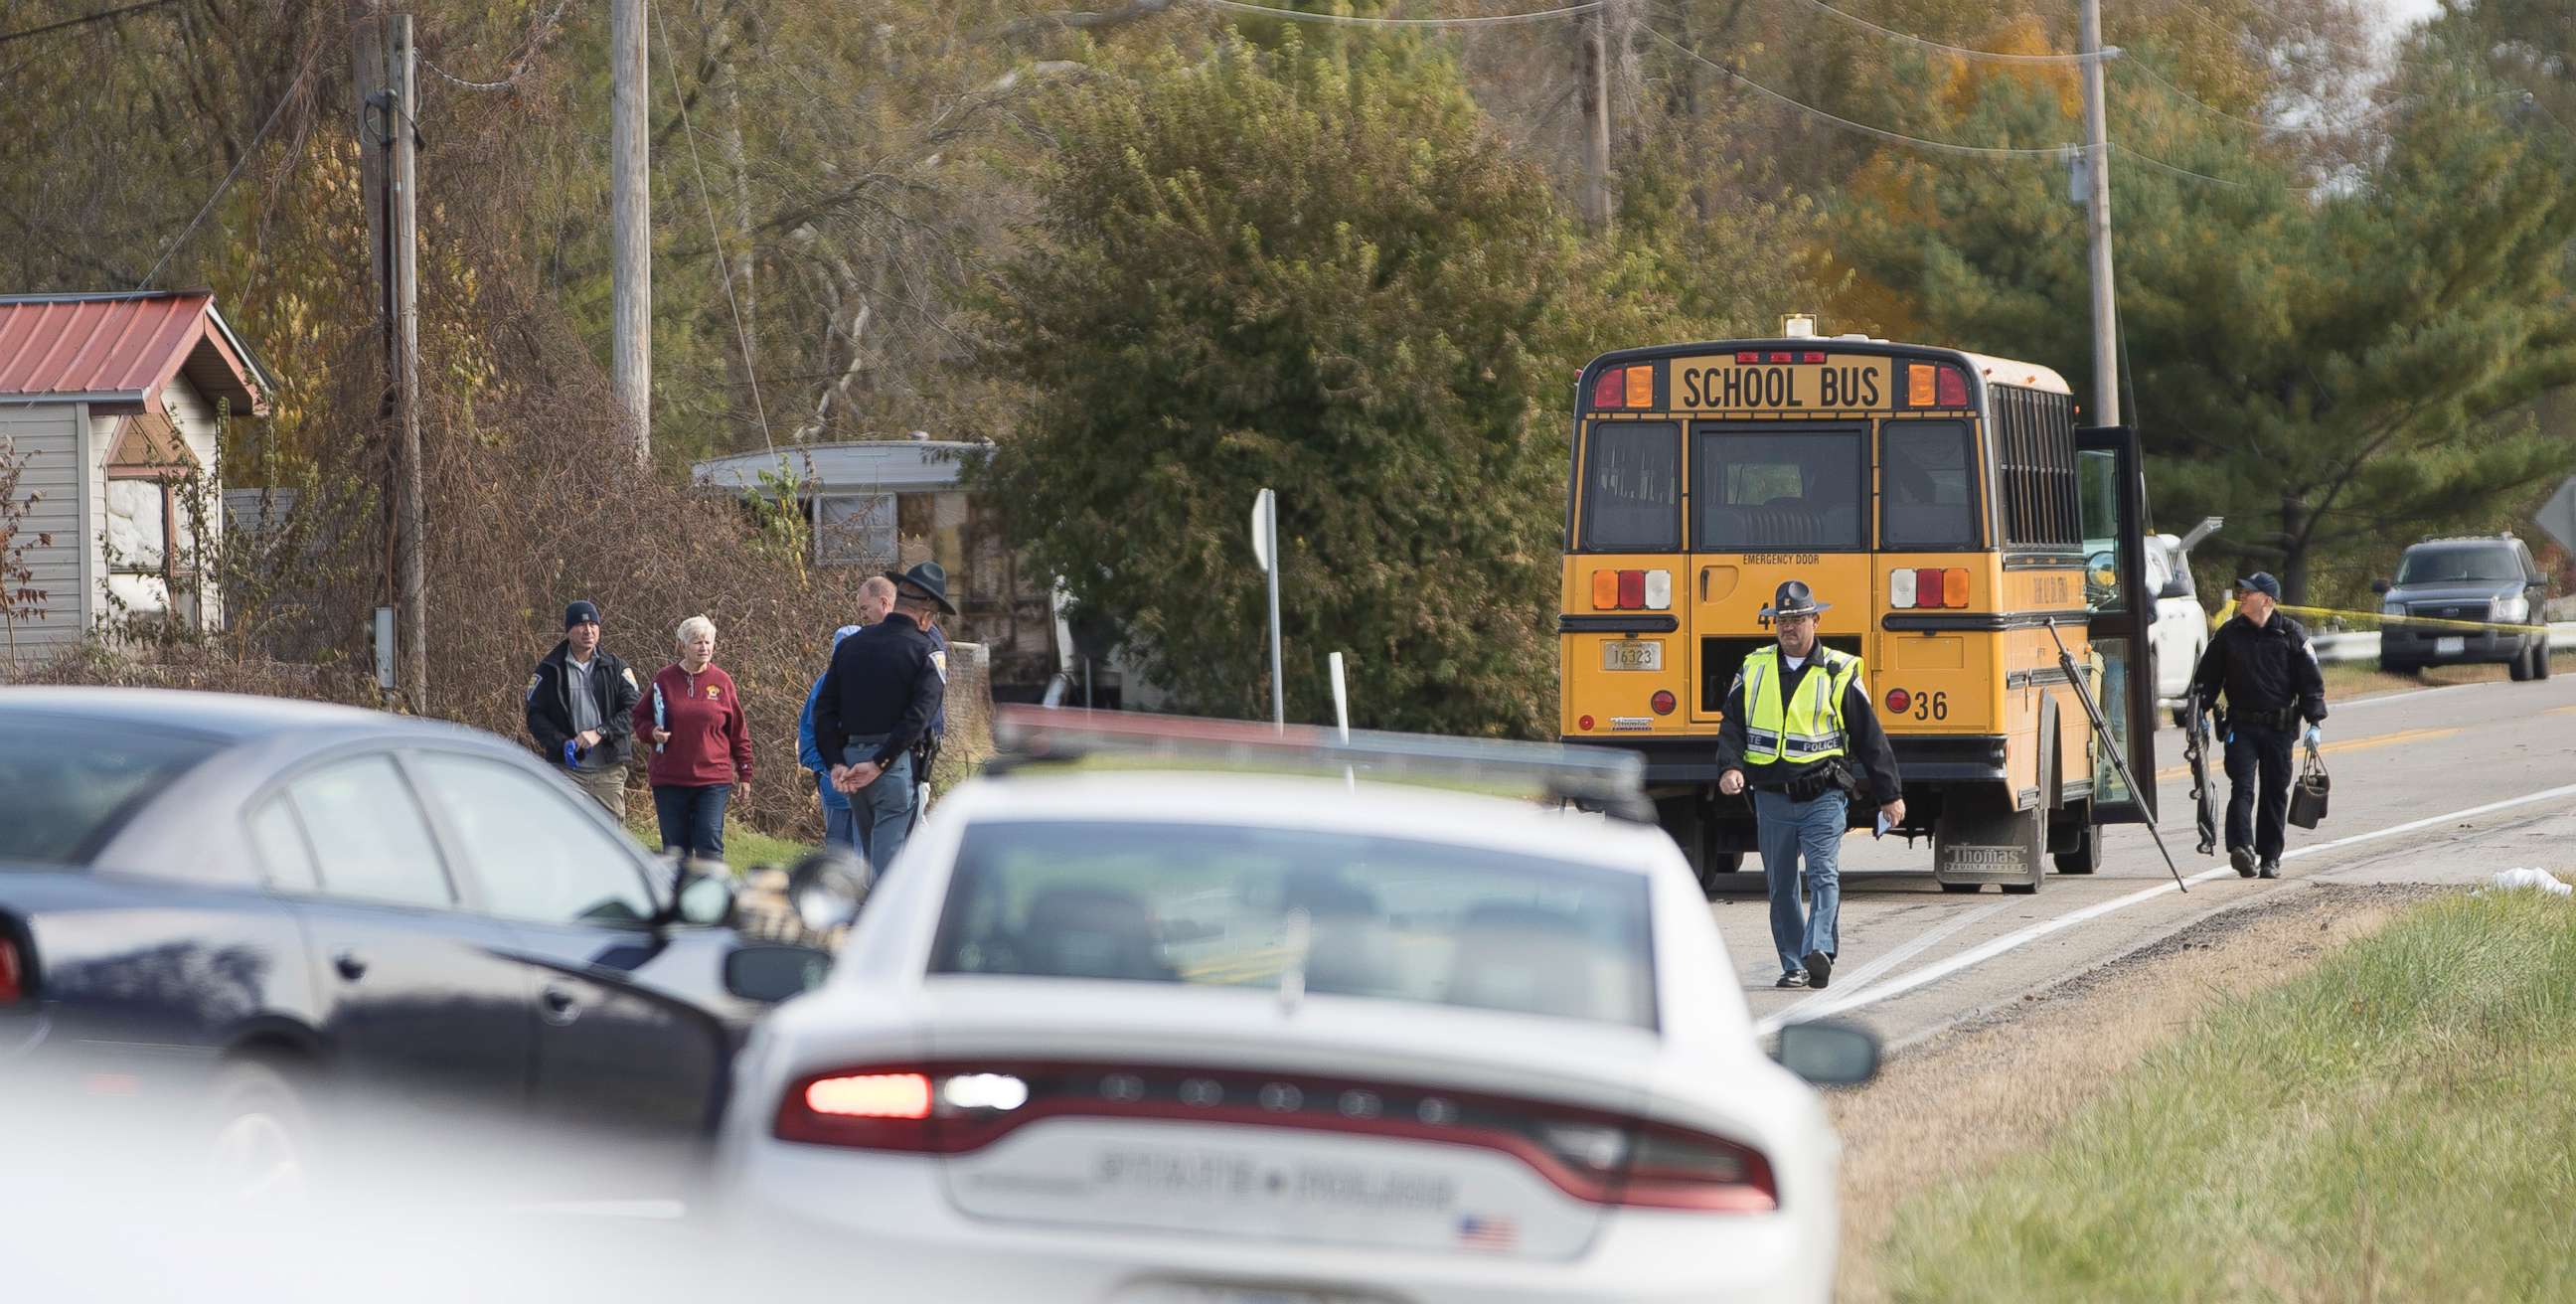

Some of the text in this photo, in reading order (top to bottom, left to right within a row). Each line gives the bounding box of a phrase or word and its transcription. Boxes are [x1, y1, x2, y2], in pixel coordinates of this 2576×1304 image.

[1684, 367, 1879, 408] SCHOOL BUS
[1743, 554, 1820, 565] EMERGENCY DOOR
[1914, 692, 1948, 721] 36
[1804, 738, 1839, 752] POLICE
[1954, 843, 2019, 864] Thomas
